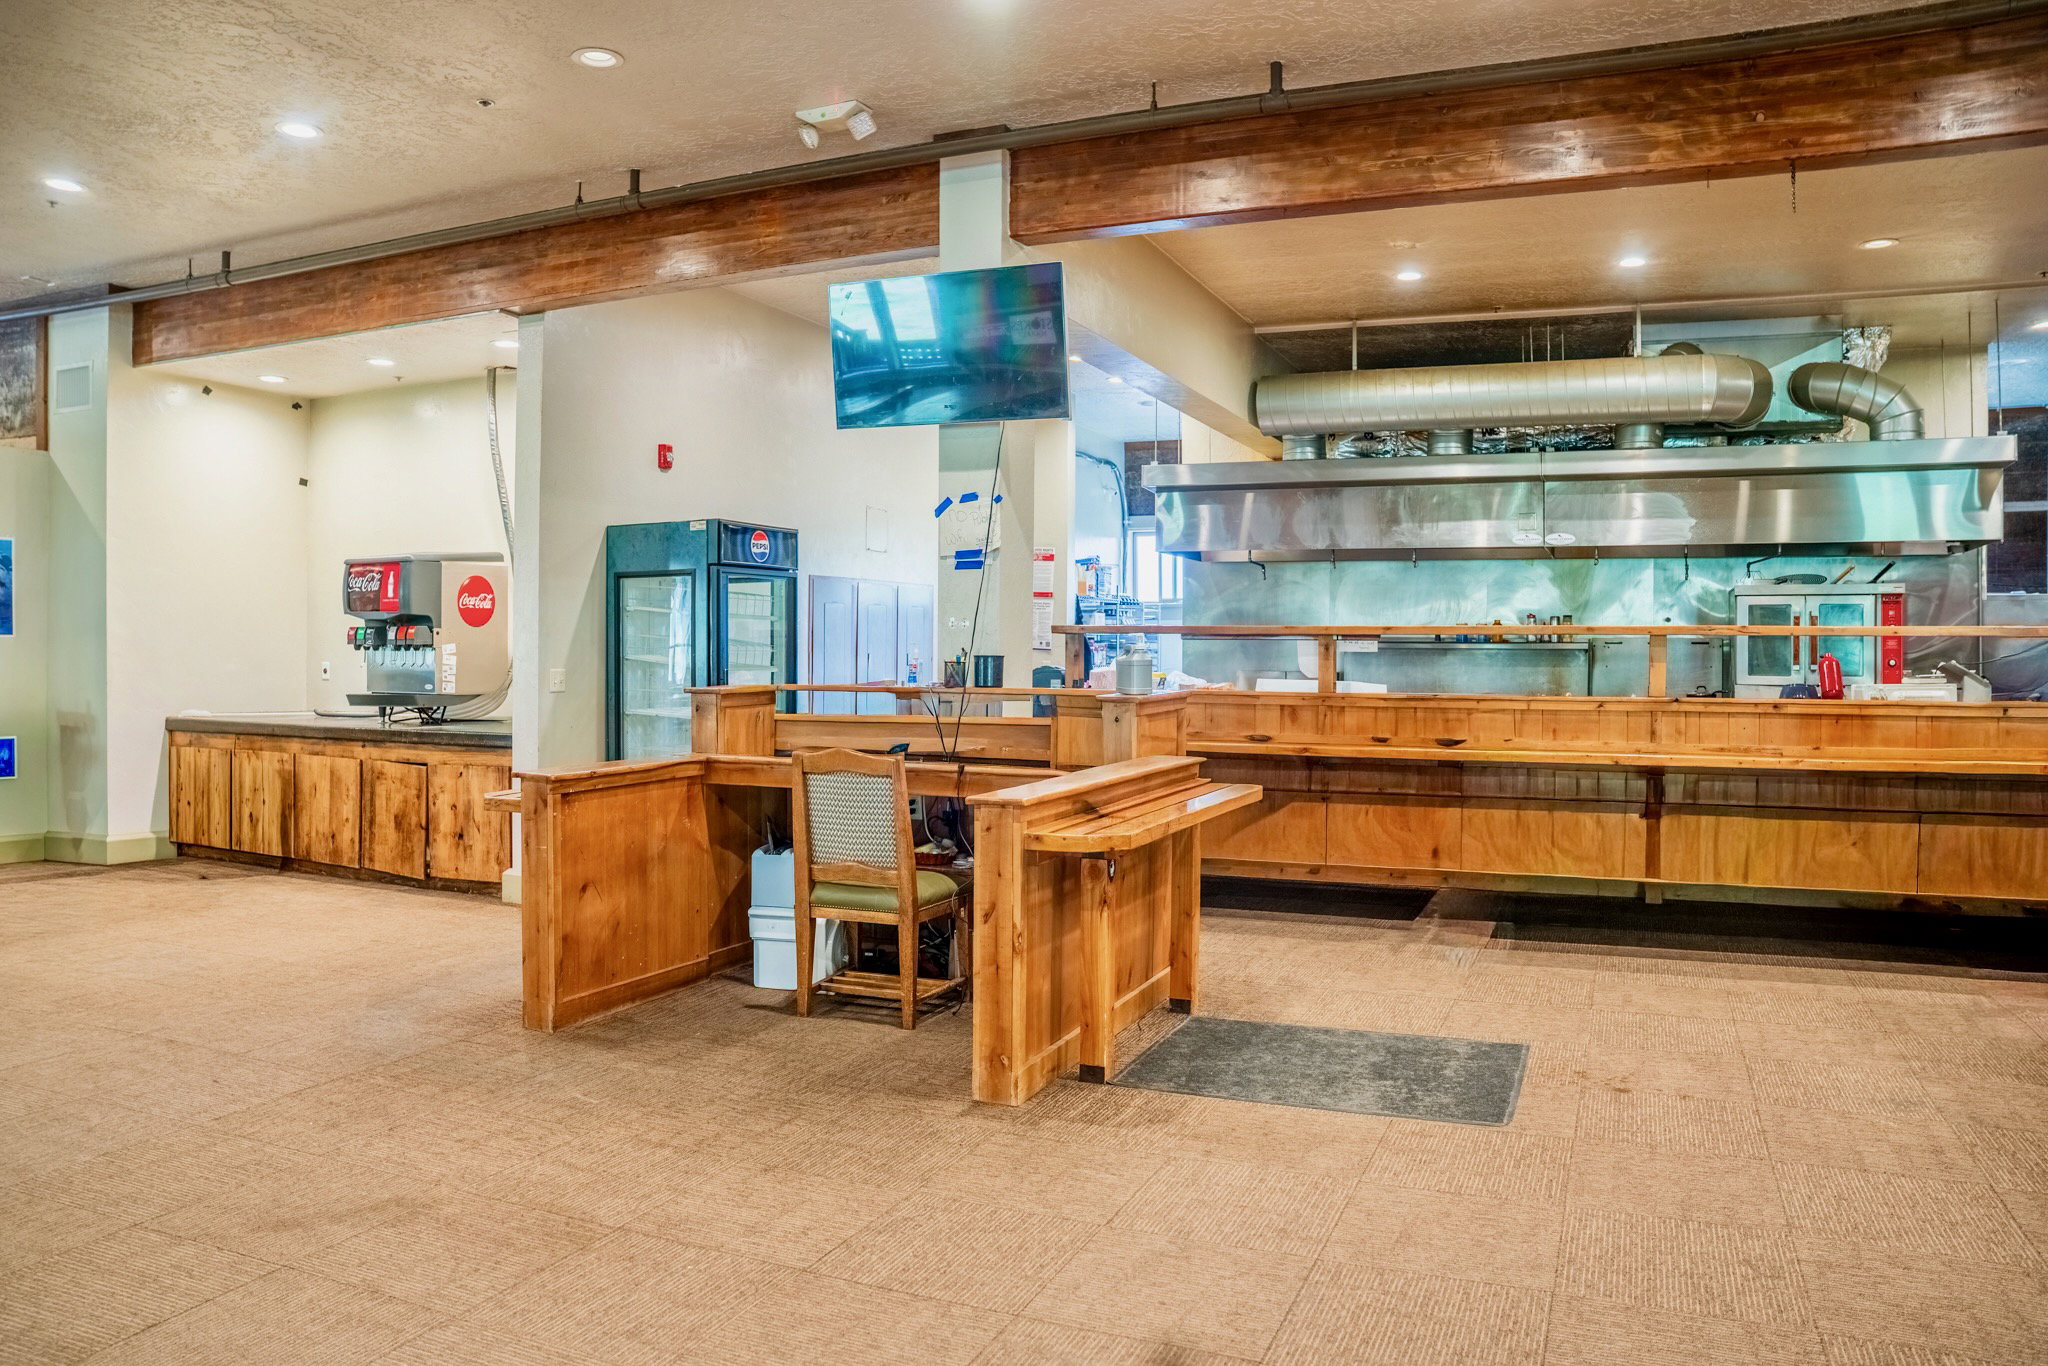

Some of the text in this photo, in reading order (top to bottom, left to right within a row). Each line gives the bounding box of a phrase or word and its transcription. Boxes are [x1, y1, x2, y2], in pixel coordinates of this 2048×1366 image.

[752, 542, 768, 550] PEPSI
[348, 572, 382, 592] Coca-Cola
[459, 592, 494, 609] Coca-Cola
